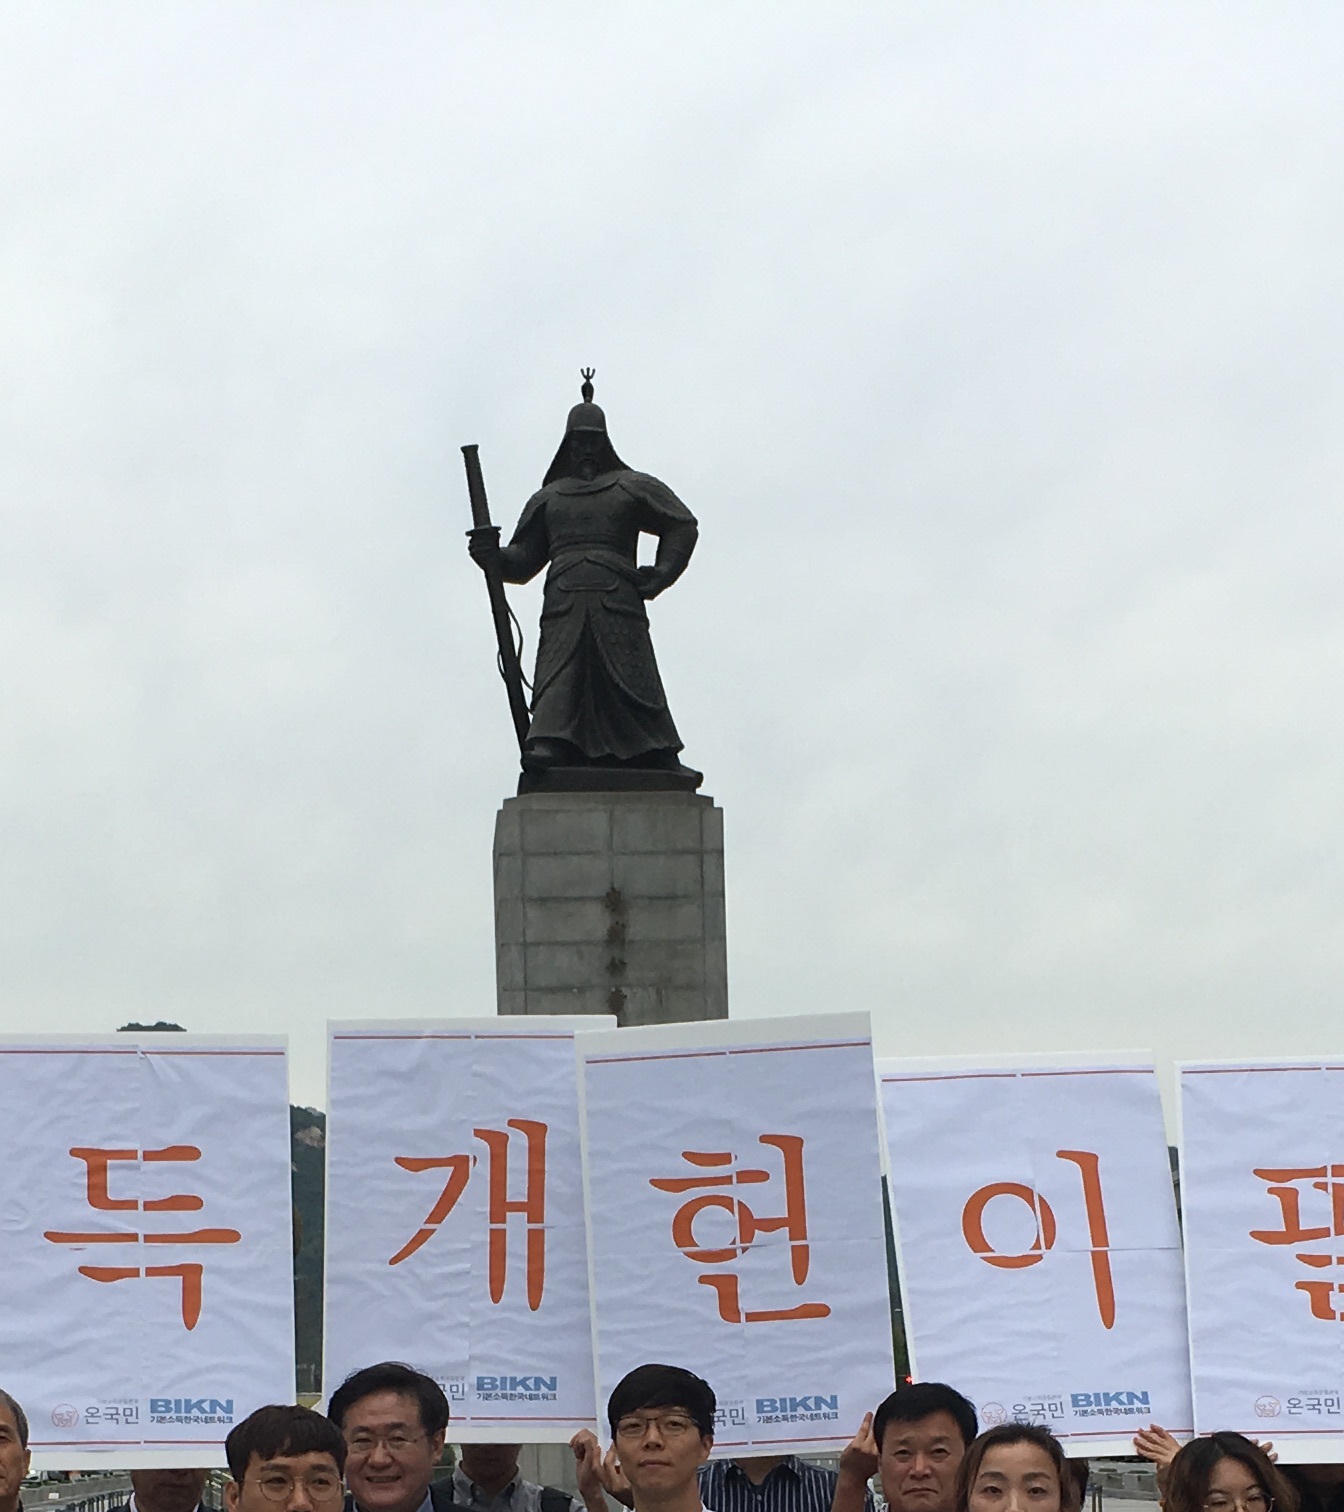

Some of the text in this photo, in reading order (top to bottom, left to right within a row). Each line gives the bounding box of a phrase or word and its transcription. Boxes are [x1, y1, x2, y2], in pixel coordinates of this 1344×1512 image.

[389, 1119, 549, 1311] 개
[649, 1133, 831, 1324] 헌
[43, 1145, 242, 1331] 득
[962, 1149, 1116, 1329] 이
[476, 1376, 558, 1392] BIKN
[476, 1392, 557, 1401] 기본소득한국네트워크
[756, 1395, 839, 1414] BIKN
[1070, 1391, 1150, 1408] BIKN
[150, 1398, 234, 1415] BIKN
[1011, 1402, 1065, 1421] 온국민
[1073, 1407, 1152, 1417] 기본소득한국네트워크
[1286, 1397, 1341, 1415] 온국민
[84, 1405, 139, 1426] 온국민
[150, 1415, 234, 1424] 기본소득한국네트워크
[713, 1407, 746, 1427] 국민
[757, 1412, 839, 1424] 기본소득한국네트워크
